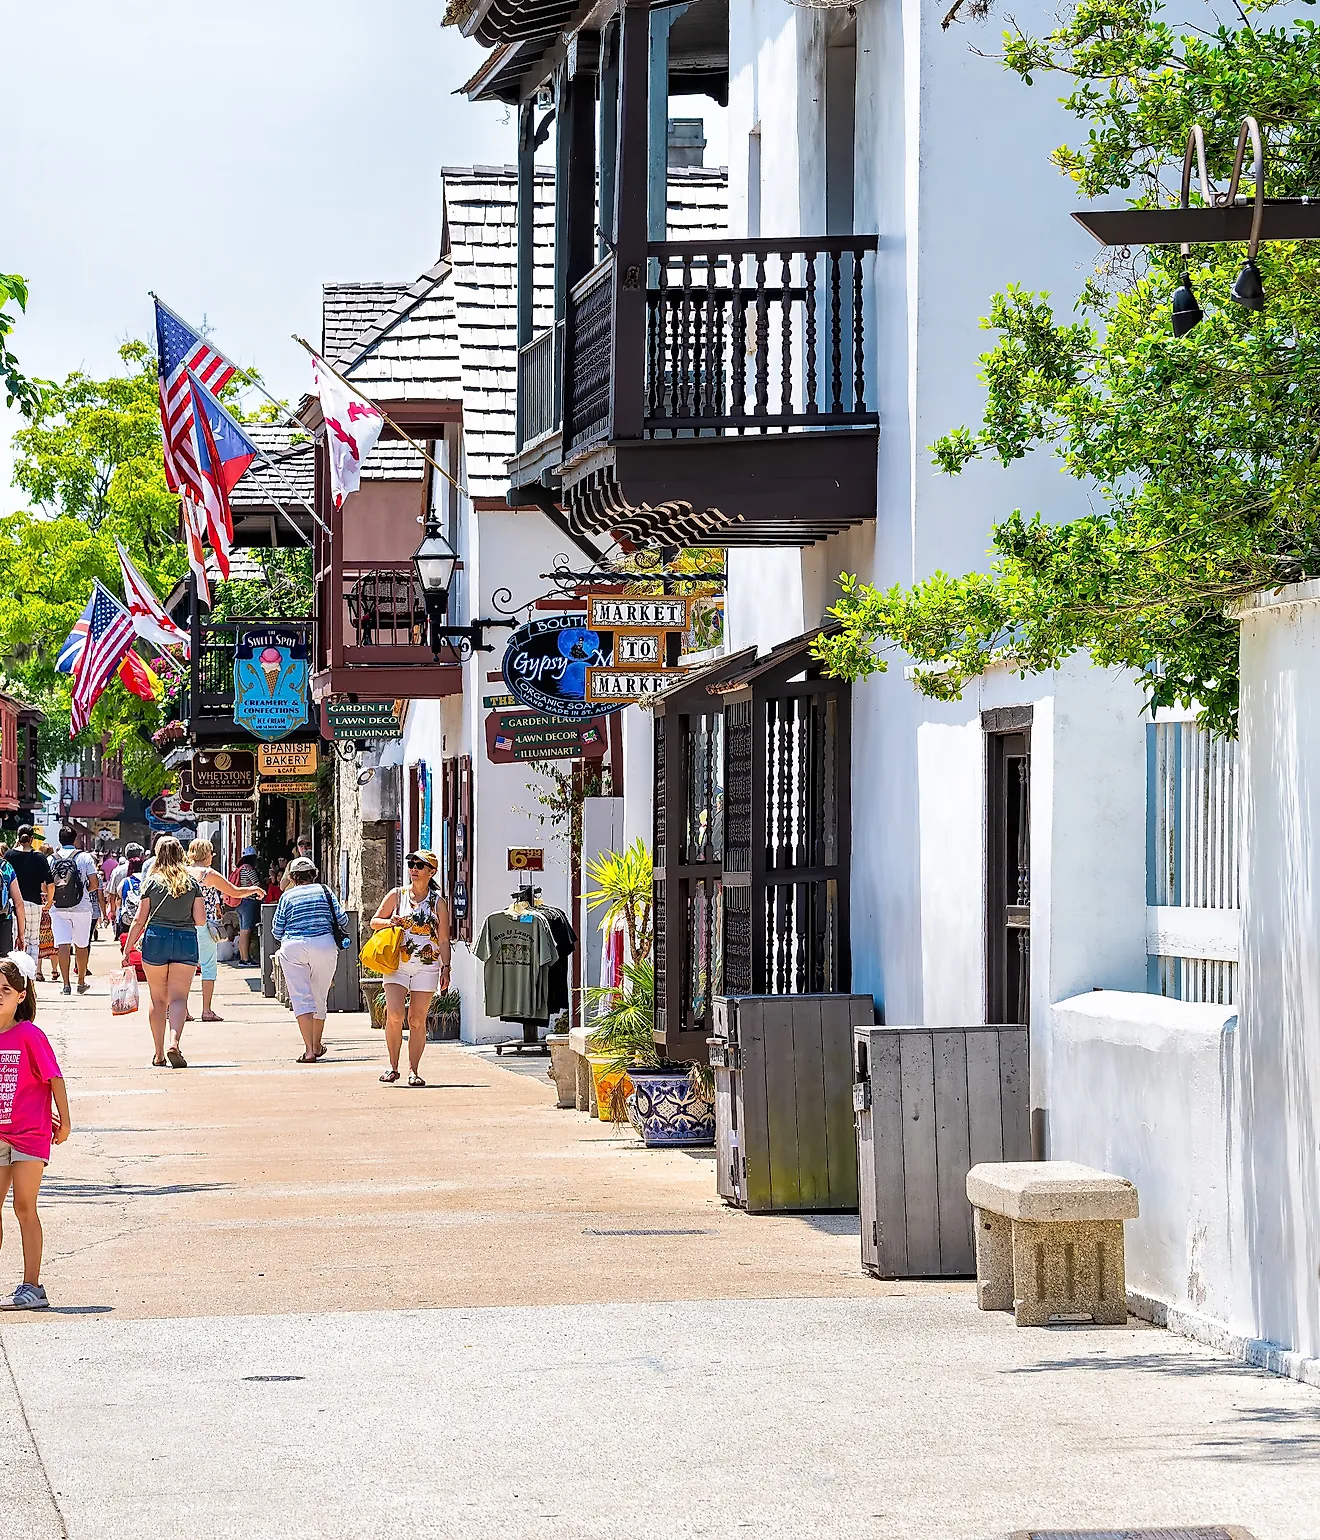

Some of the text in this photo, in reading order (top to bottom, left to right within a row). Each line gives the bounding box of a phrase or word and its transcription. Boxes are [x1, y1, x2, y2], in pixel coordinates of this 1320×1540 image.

[599, 606, 677, 620] MARKET
[536, 616, 588, 632] BOUTI
[247, 634, 296, 647] SWEET SPOT
[627, 642, 650, 656] TO
[513, 652, 568, 681] Gypsy
[598, 678, 672, 692] MARKE
[490, 696, 515, 706] THE
[519, 682, 564, 708] ORGANIC
[331, 705, 374, 713] GARDEN
[523, 693, 544, 707] HAND
[545, 705, 569, 715] MADE
[335, 717, 366, 725] LAWN
[508, 717, 549, 727] GARDEN
[518, 731, 576, 743] LAWN DECOR
[263, 744, 311, 753] SPANISH
[521, 747, 574, 758] ILLUMINART
[266, 755, 308, 765] BAKERY
[197, 771, 251, 780] WHETSTONE
